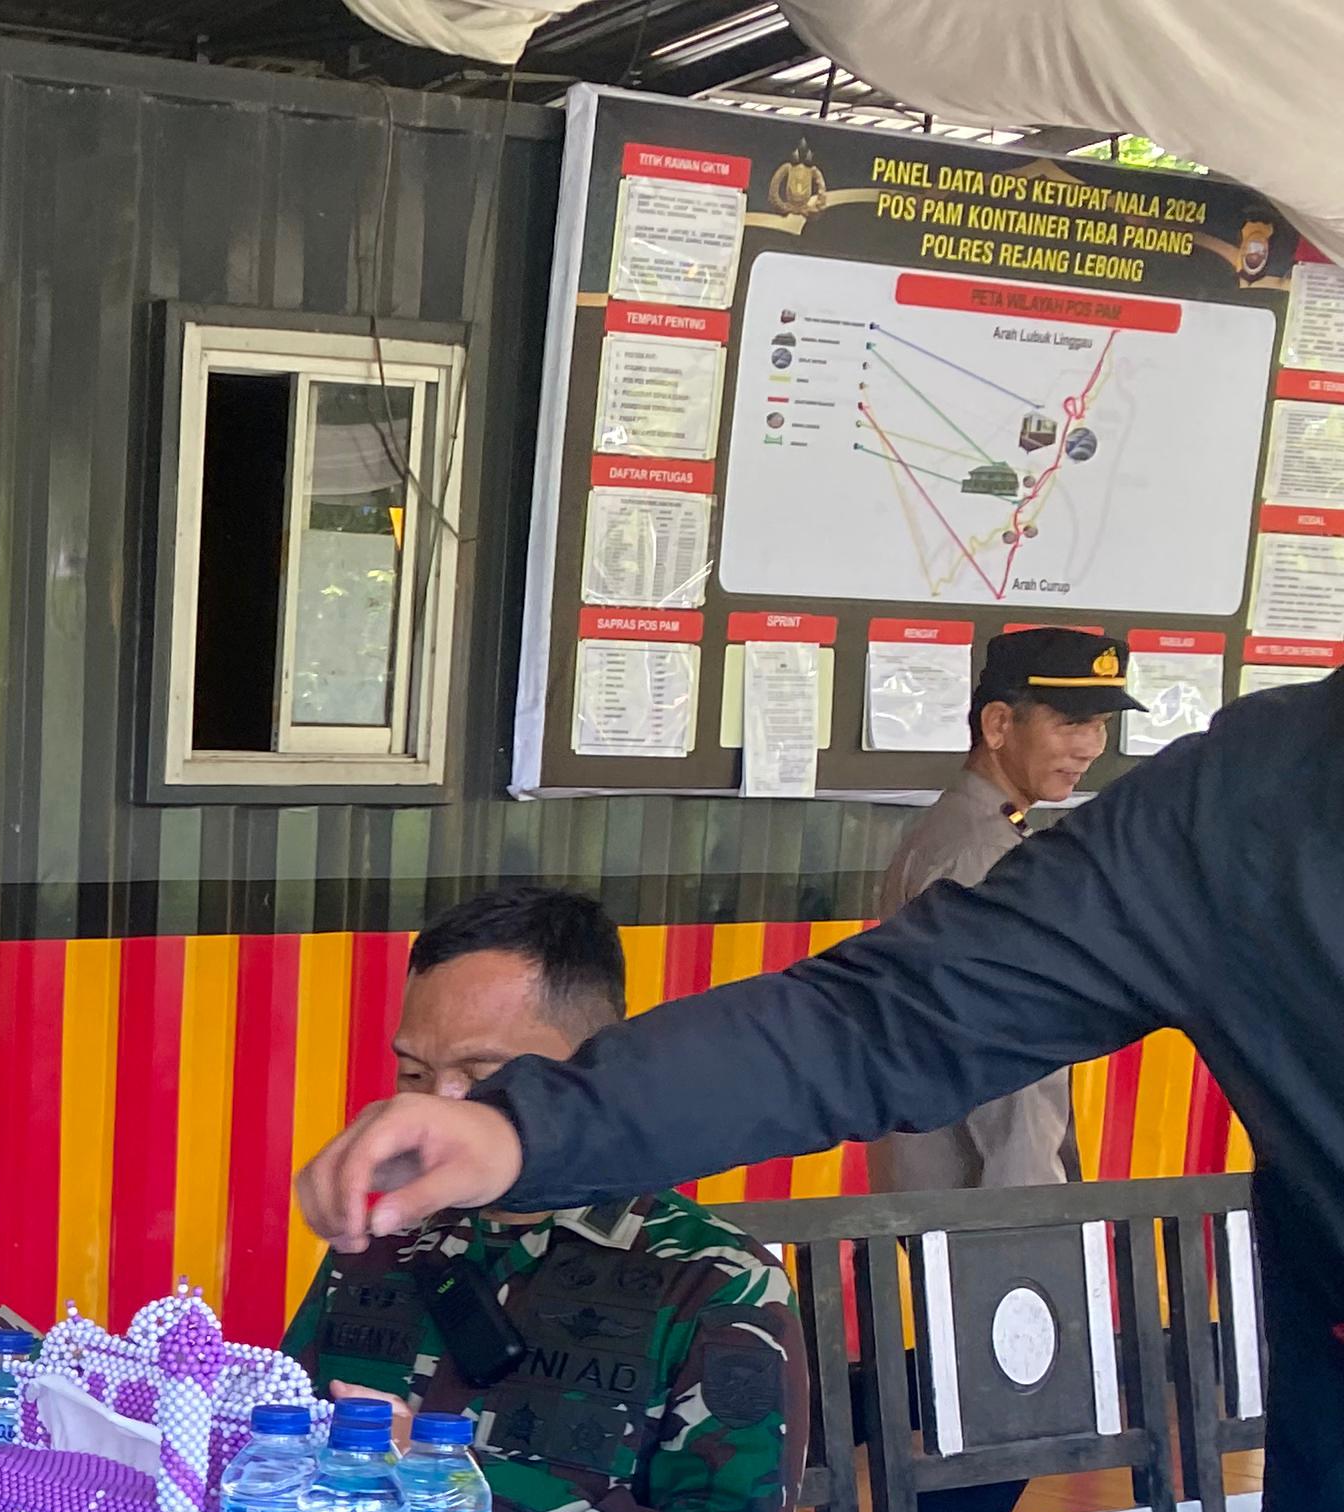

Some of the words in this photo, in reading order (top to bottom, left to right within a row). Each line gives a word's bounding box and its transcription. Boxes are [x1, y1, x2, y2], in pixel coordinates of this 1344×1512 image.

[871, 157, 932, 188] PANEL
[938, 166, 985, 195] DATA
[990, 173, 1028, 201] OPS
[1032, 180, 1110, 210] KETUPAT
[1115, 191, 1161, 219] NALA
[1164, 198, 1208, 225] 2024
[877, 193, 916, 221] POS
[921, 199, 963, 227] PAM
[967, 205, 1070, 240] KONTAINER
[1075, 219, 1118, 247] TABA
[1122, 225, 1194, 256] PADANG
[920, 234, 994, 266] POLRES
[999, 244, 1071, 274] REJANG
[1074, 253, 1145, 282] LEBONG
[626, 311, 663, 326] TEMPAT
[664, 316, 707, 330] PENTING
[993, 327, 1017, 341] Arah
[609, 467, 648, 480] DAFTAR
[649, 470, 694, 484] PETUGAS
[1012, 578, 1037, 591] Arah
[597, 618, 637, 630] SAPRAS
[637, 620, 658, 631] POS
[659, 620, 680, 632] PAM
[766, 615, 802, 628] SPRINT
